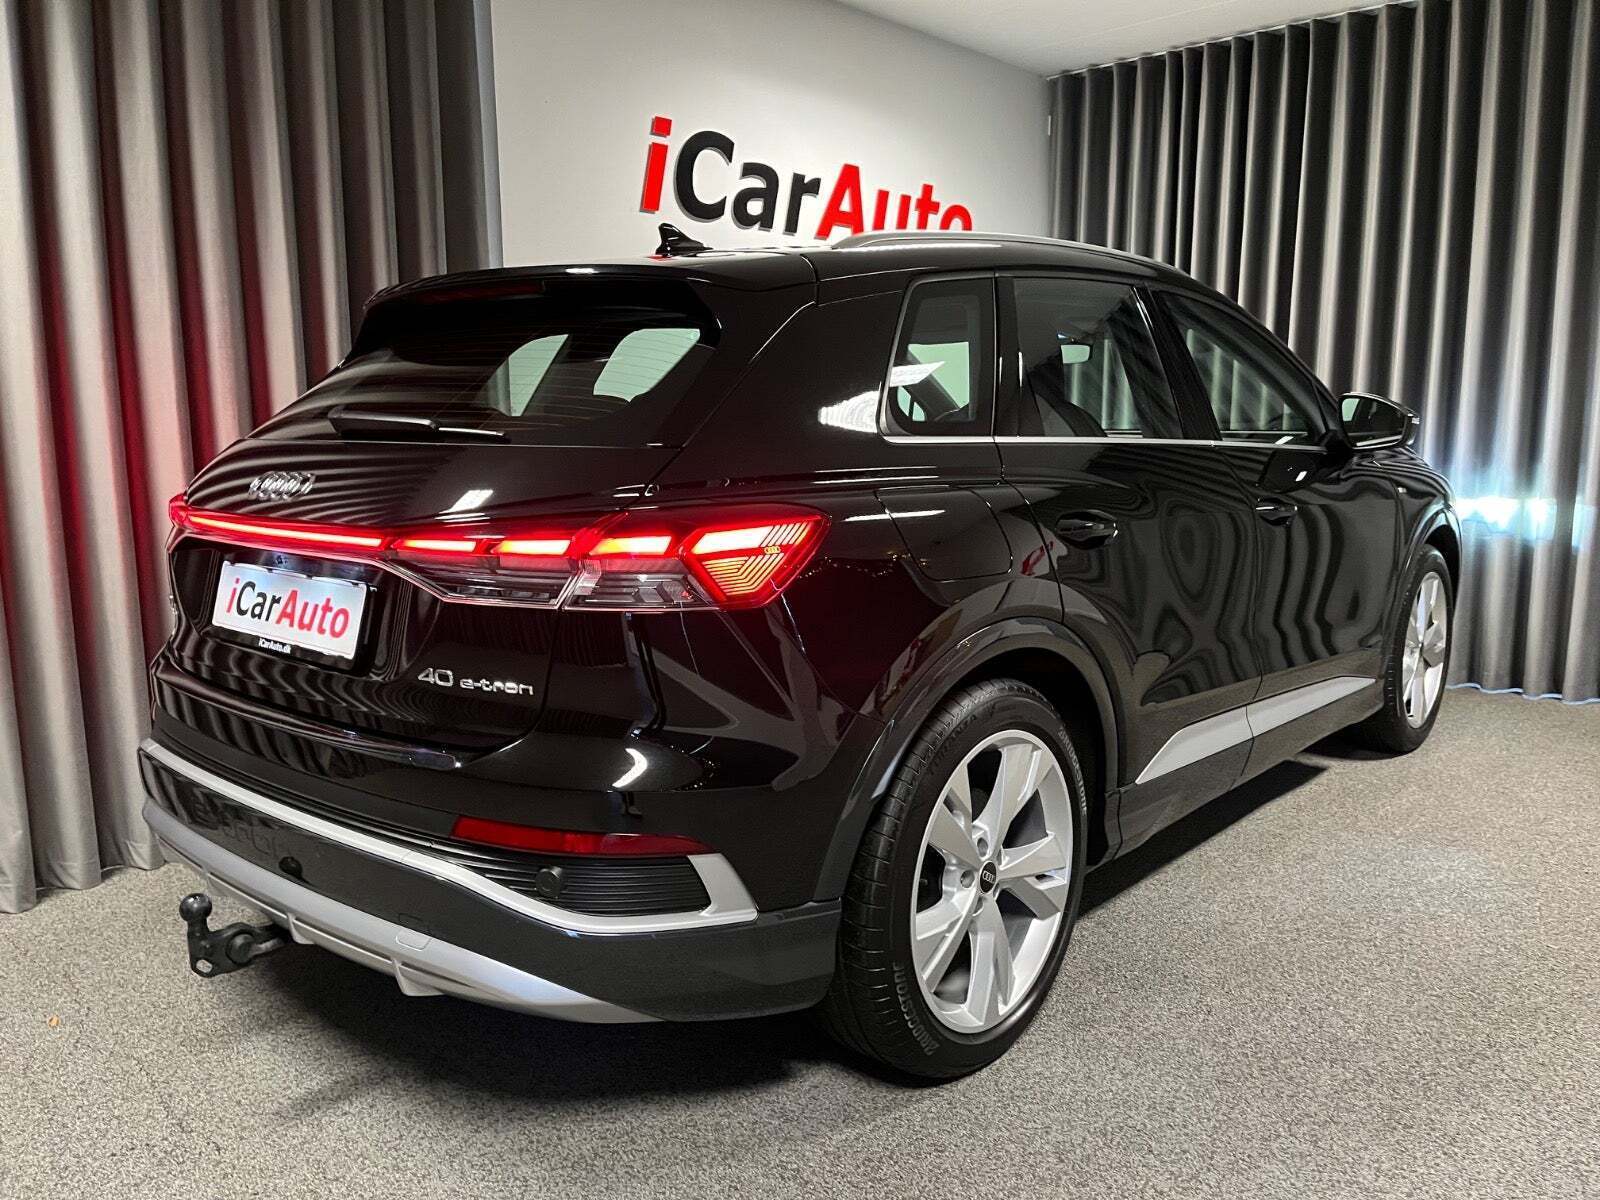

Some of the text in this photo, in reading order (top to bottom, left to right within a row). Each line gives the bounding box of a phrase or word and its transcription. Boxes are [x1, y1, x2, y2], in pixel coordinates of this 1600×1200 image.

[641, 116, 972, 240] iCarAuto
[226, 577, 350, 638] iCarAuto
[418, 667, 533, 695] 40 e-tron
